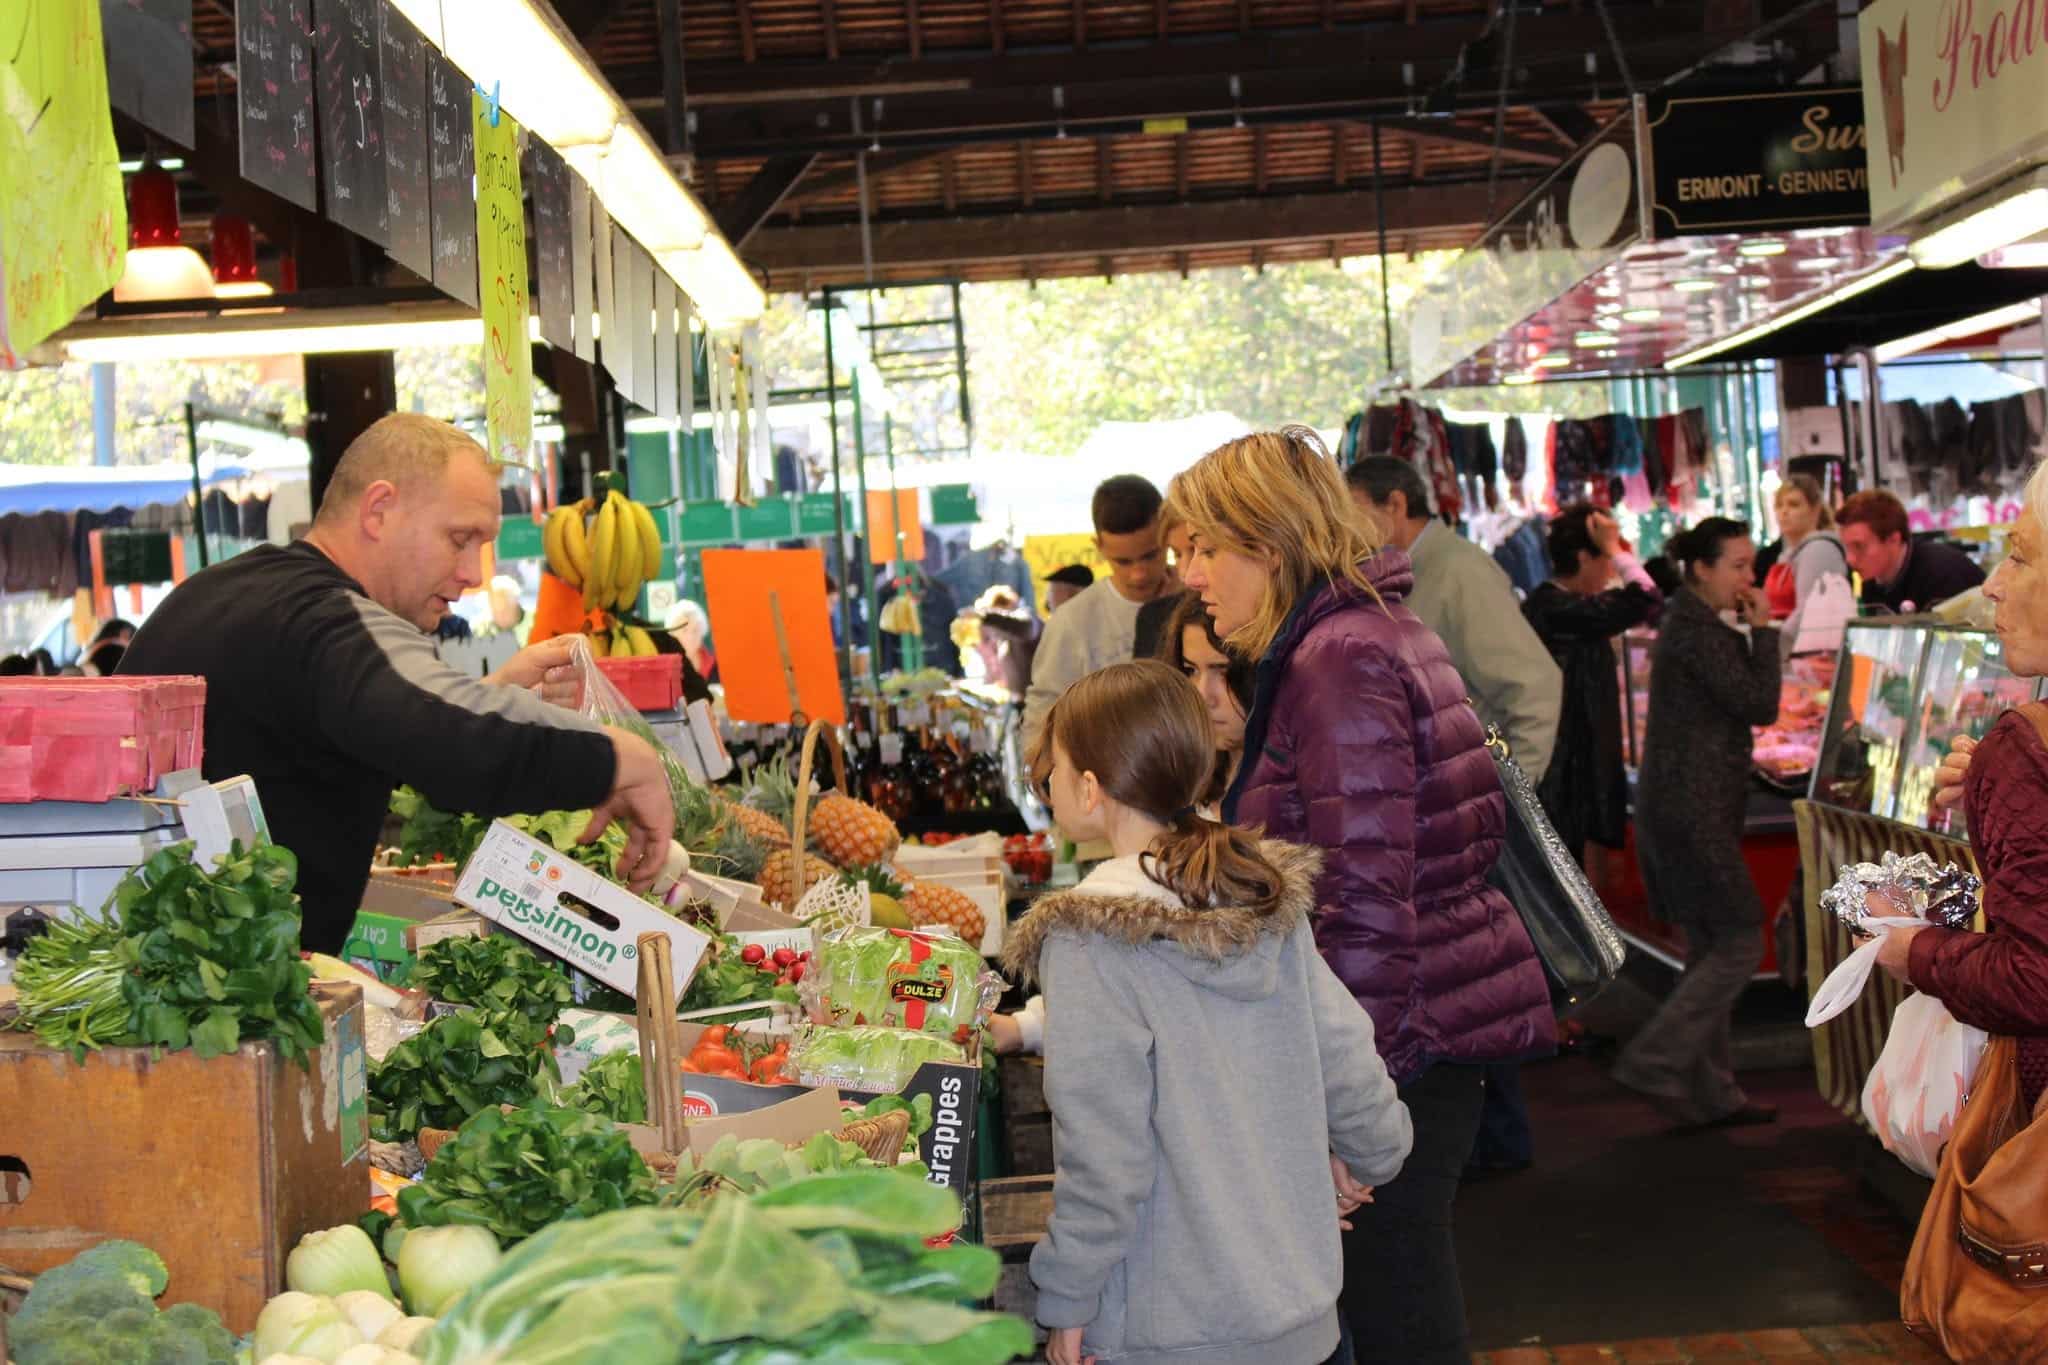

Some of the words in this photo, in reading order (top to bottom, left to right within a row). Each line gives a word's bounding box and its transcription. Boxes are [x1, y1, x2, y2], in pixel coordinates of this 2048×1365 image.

[1933, 0, 2048, 112] Prod
[1677, 174, 1761, 201] ERMONT
[903, 983, 943, 998] DULZE
[924, 1076, 963, 1189] Grappes
